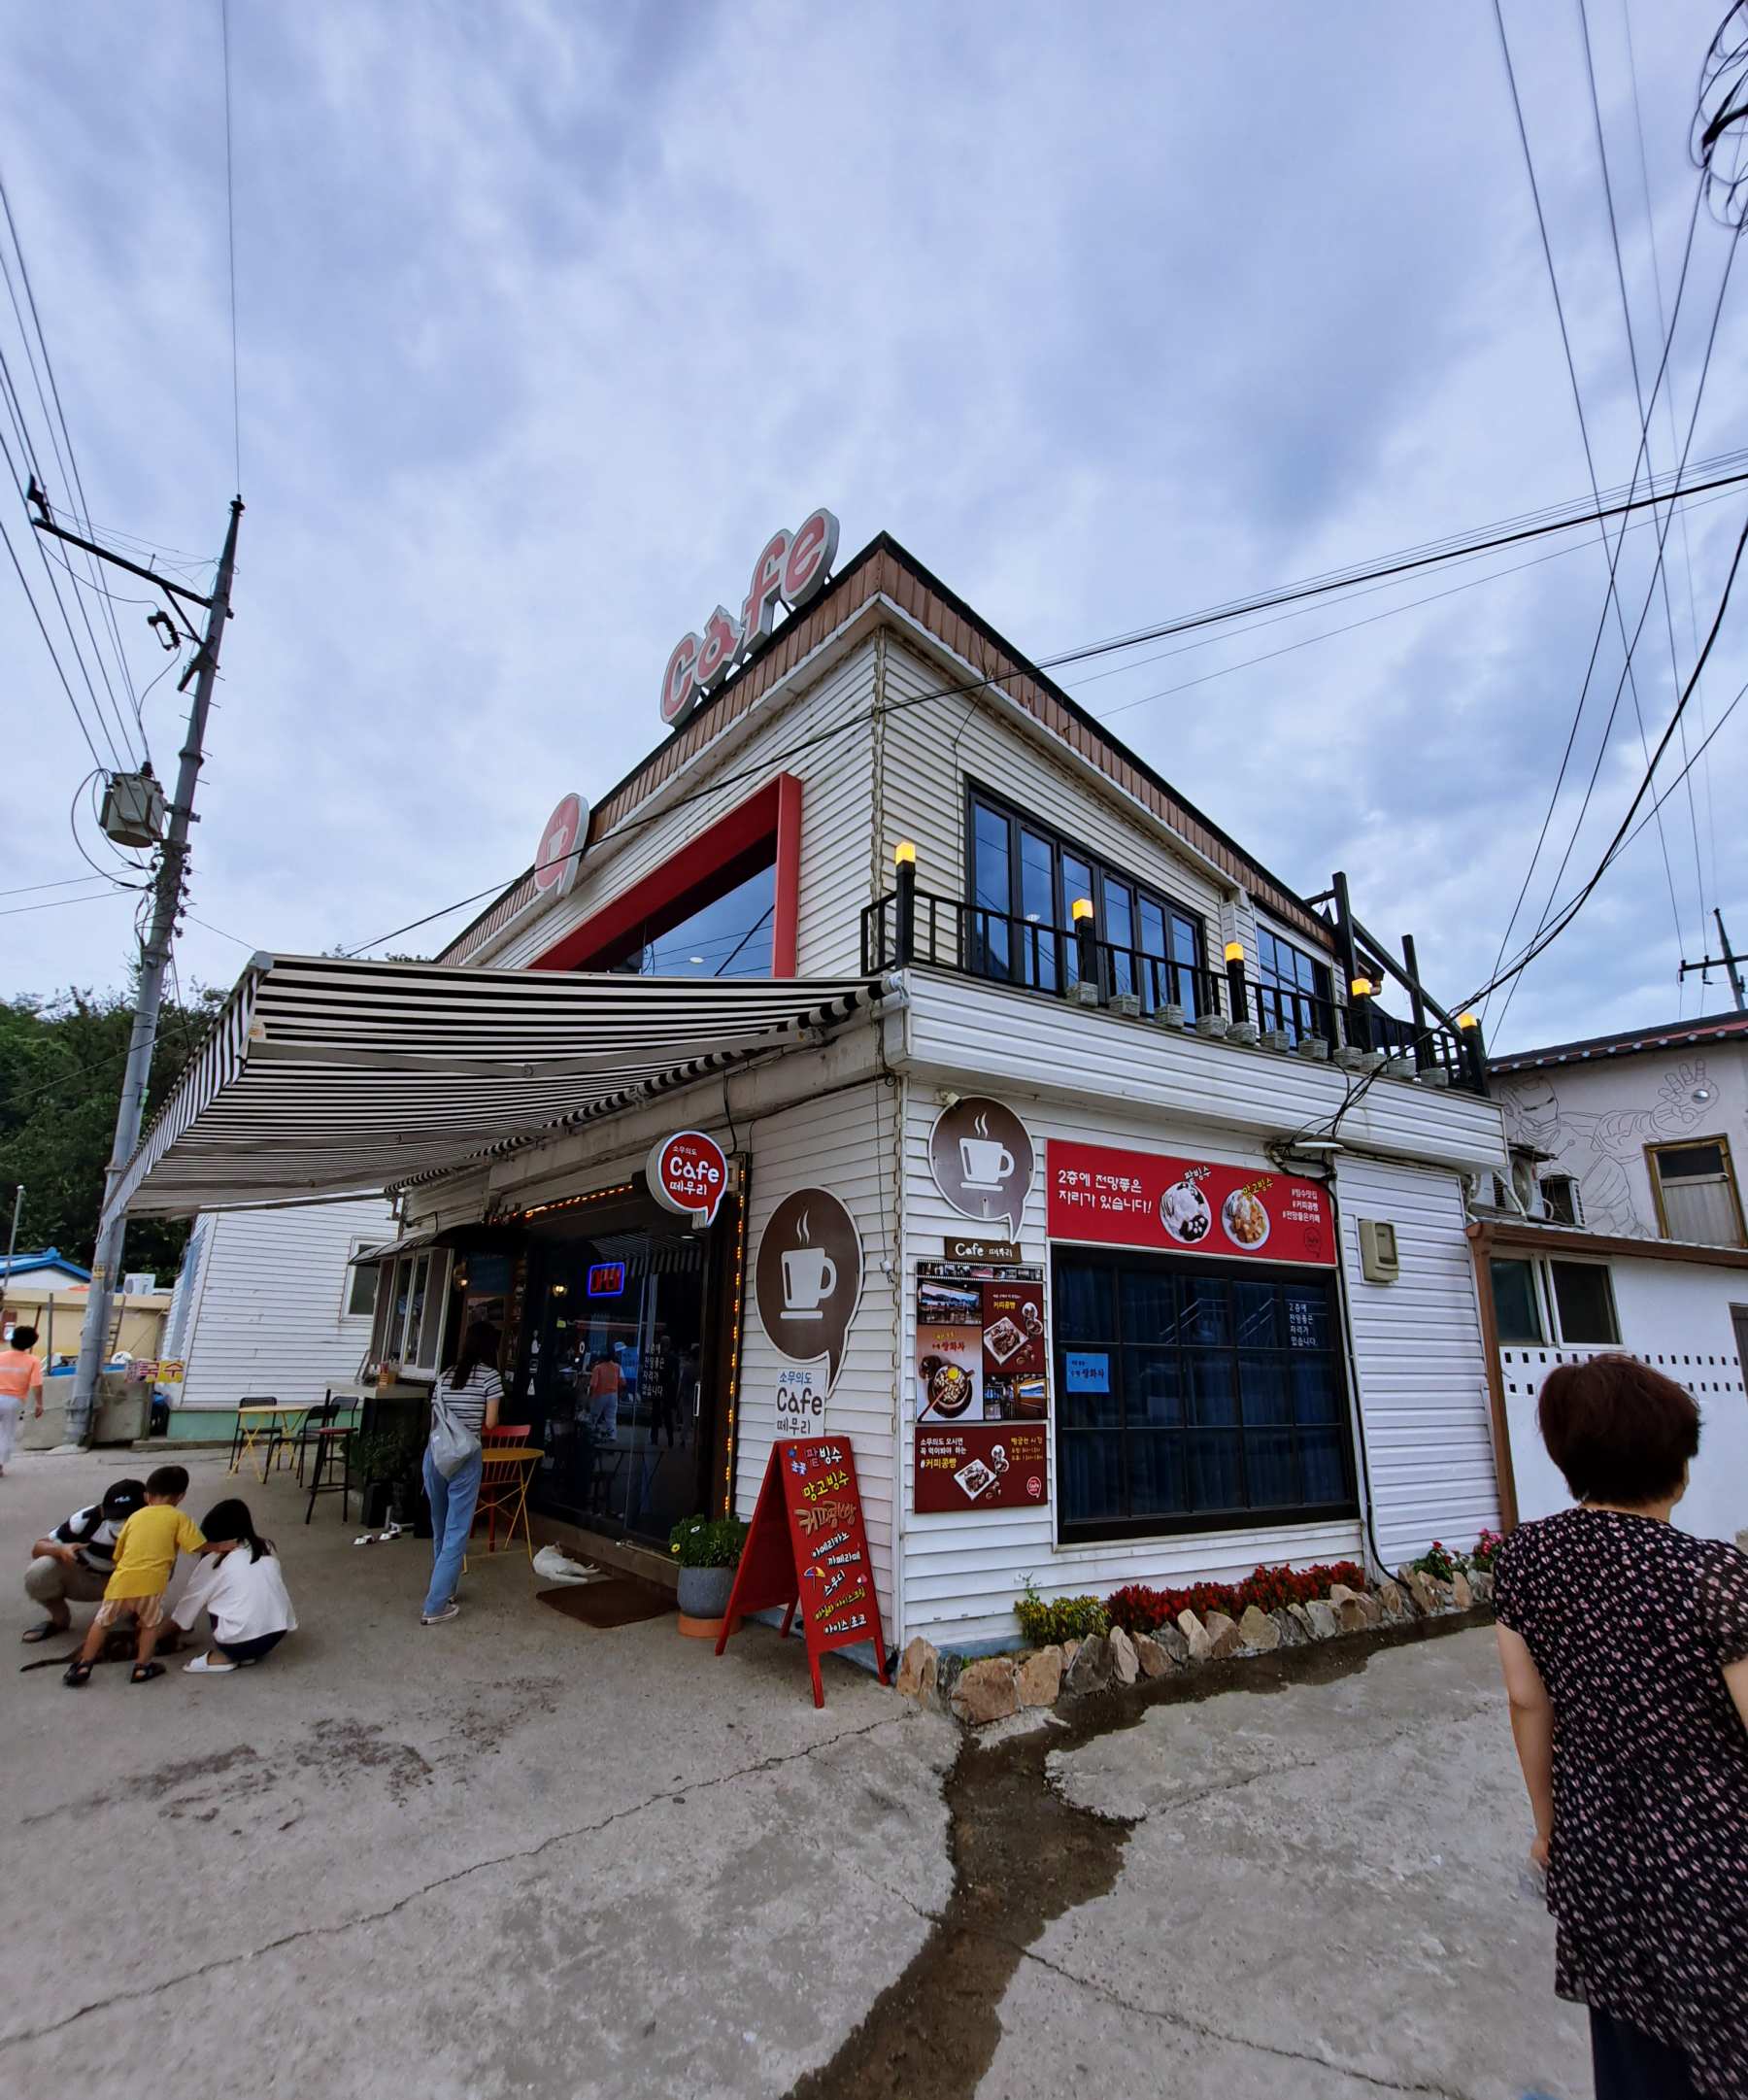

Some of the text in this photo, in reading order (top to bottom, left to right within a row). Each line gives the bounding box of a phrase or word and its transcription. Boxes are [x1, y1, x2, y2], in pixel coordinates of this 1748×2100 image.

[661, 509, 838, 727] Cafe
[673, 1146, 697, 1156] 소무의도
[670, 1156, 720, 1183] Cafe
[1058, 1169, 1143, 1194] 2층에 전망좋은
[1058, 1190, 1153, 1214] 자리가 있습니다!
[955, 1242, 985, 1257] Cafe
[590, 1267, 622, 1292] OPEN
[779, 1371, 812, 1385] 소무의도
[777, 1387, 823, 1416] Cafe
[777, 1416, 811, 1436] 떼무리
[803, 1470, 850, 1502] 망고빙수
[824, 1569, 846, 1597] 스무디
